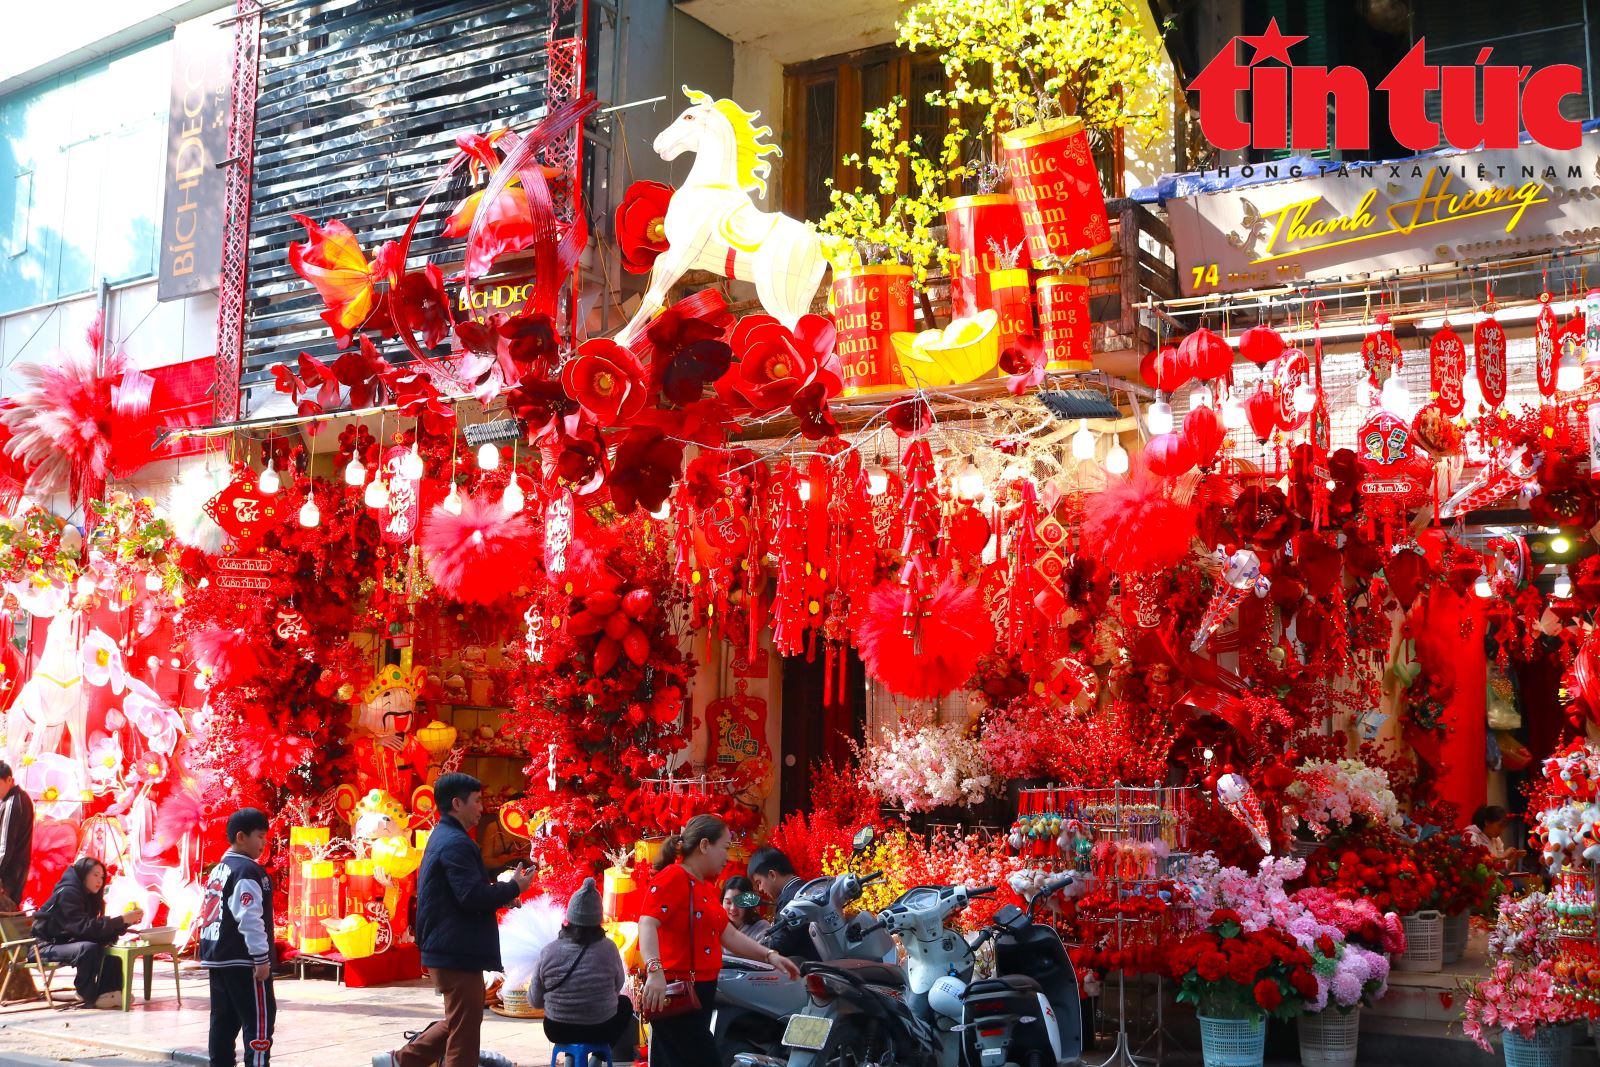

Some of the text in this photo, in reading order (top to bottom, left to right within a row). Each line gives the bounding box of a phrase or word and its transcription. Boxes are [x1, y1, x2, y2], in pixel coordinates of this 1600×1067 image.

[1009, 153, 1058, 177] Chúc
[1260, 188, 1377, 253] Thanh
[1192, 263, 1220, 289] 74
[834, 282, 880, 309] Chúc
[838, 334, 878, 357] năm
